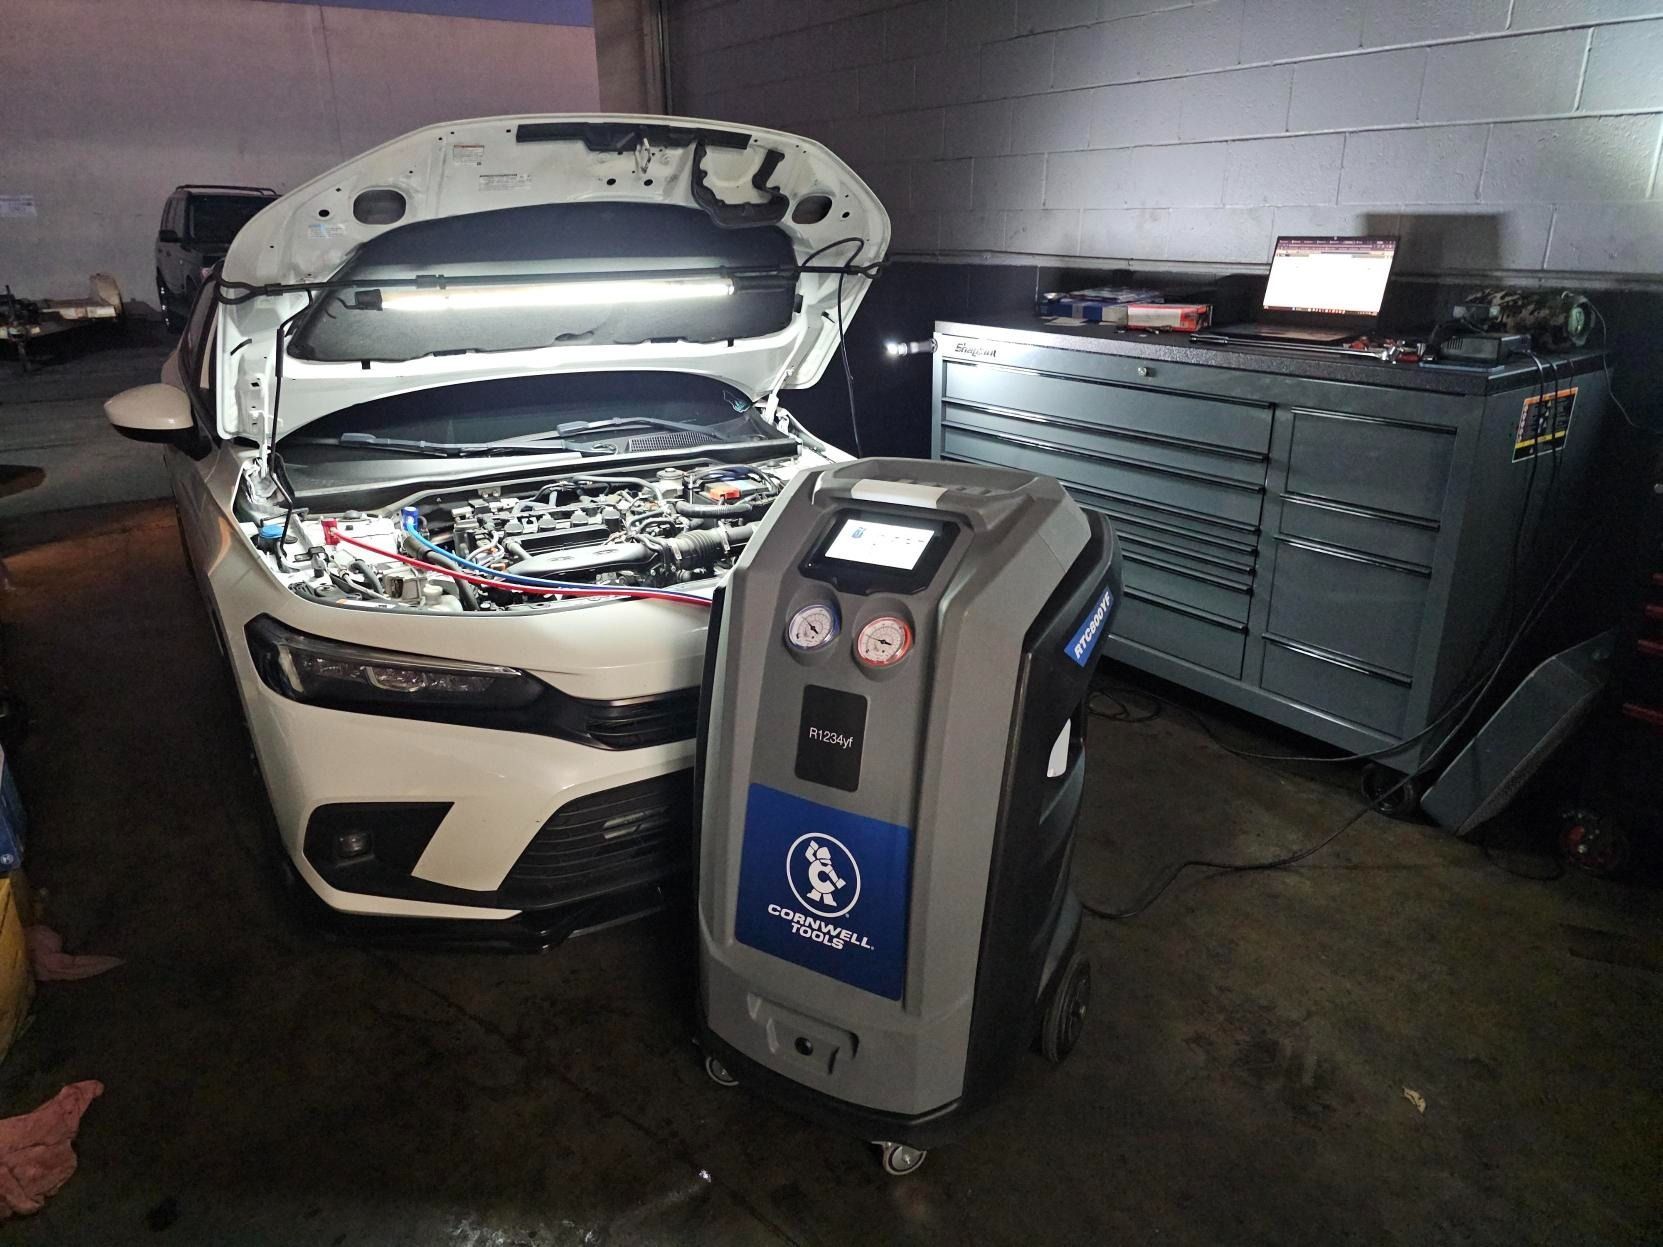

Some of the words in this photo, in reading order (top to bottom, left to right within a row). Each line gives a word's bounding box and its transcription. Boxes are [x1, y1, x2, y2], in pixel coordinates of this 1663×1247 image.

[1074, 591, 1110, 659] RTC800YF
[809, 726, 854, 749] R1234yf
[767, 903, 871, 949] CORNWELL
[791, 922, 845, 950] TOOLS
